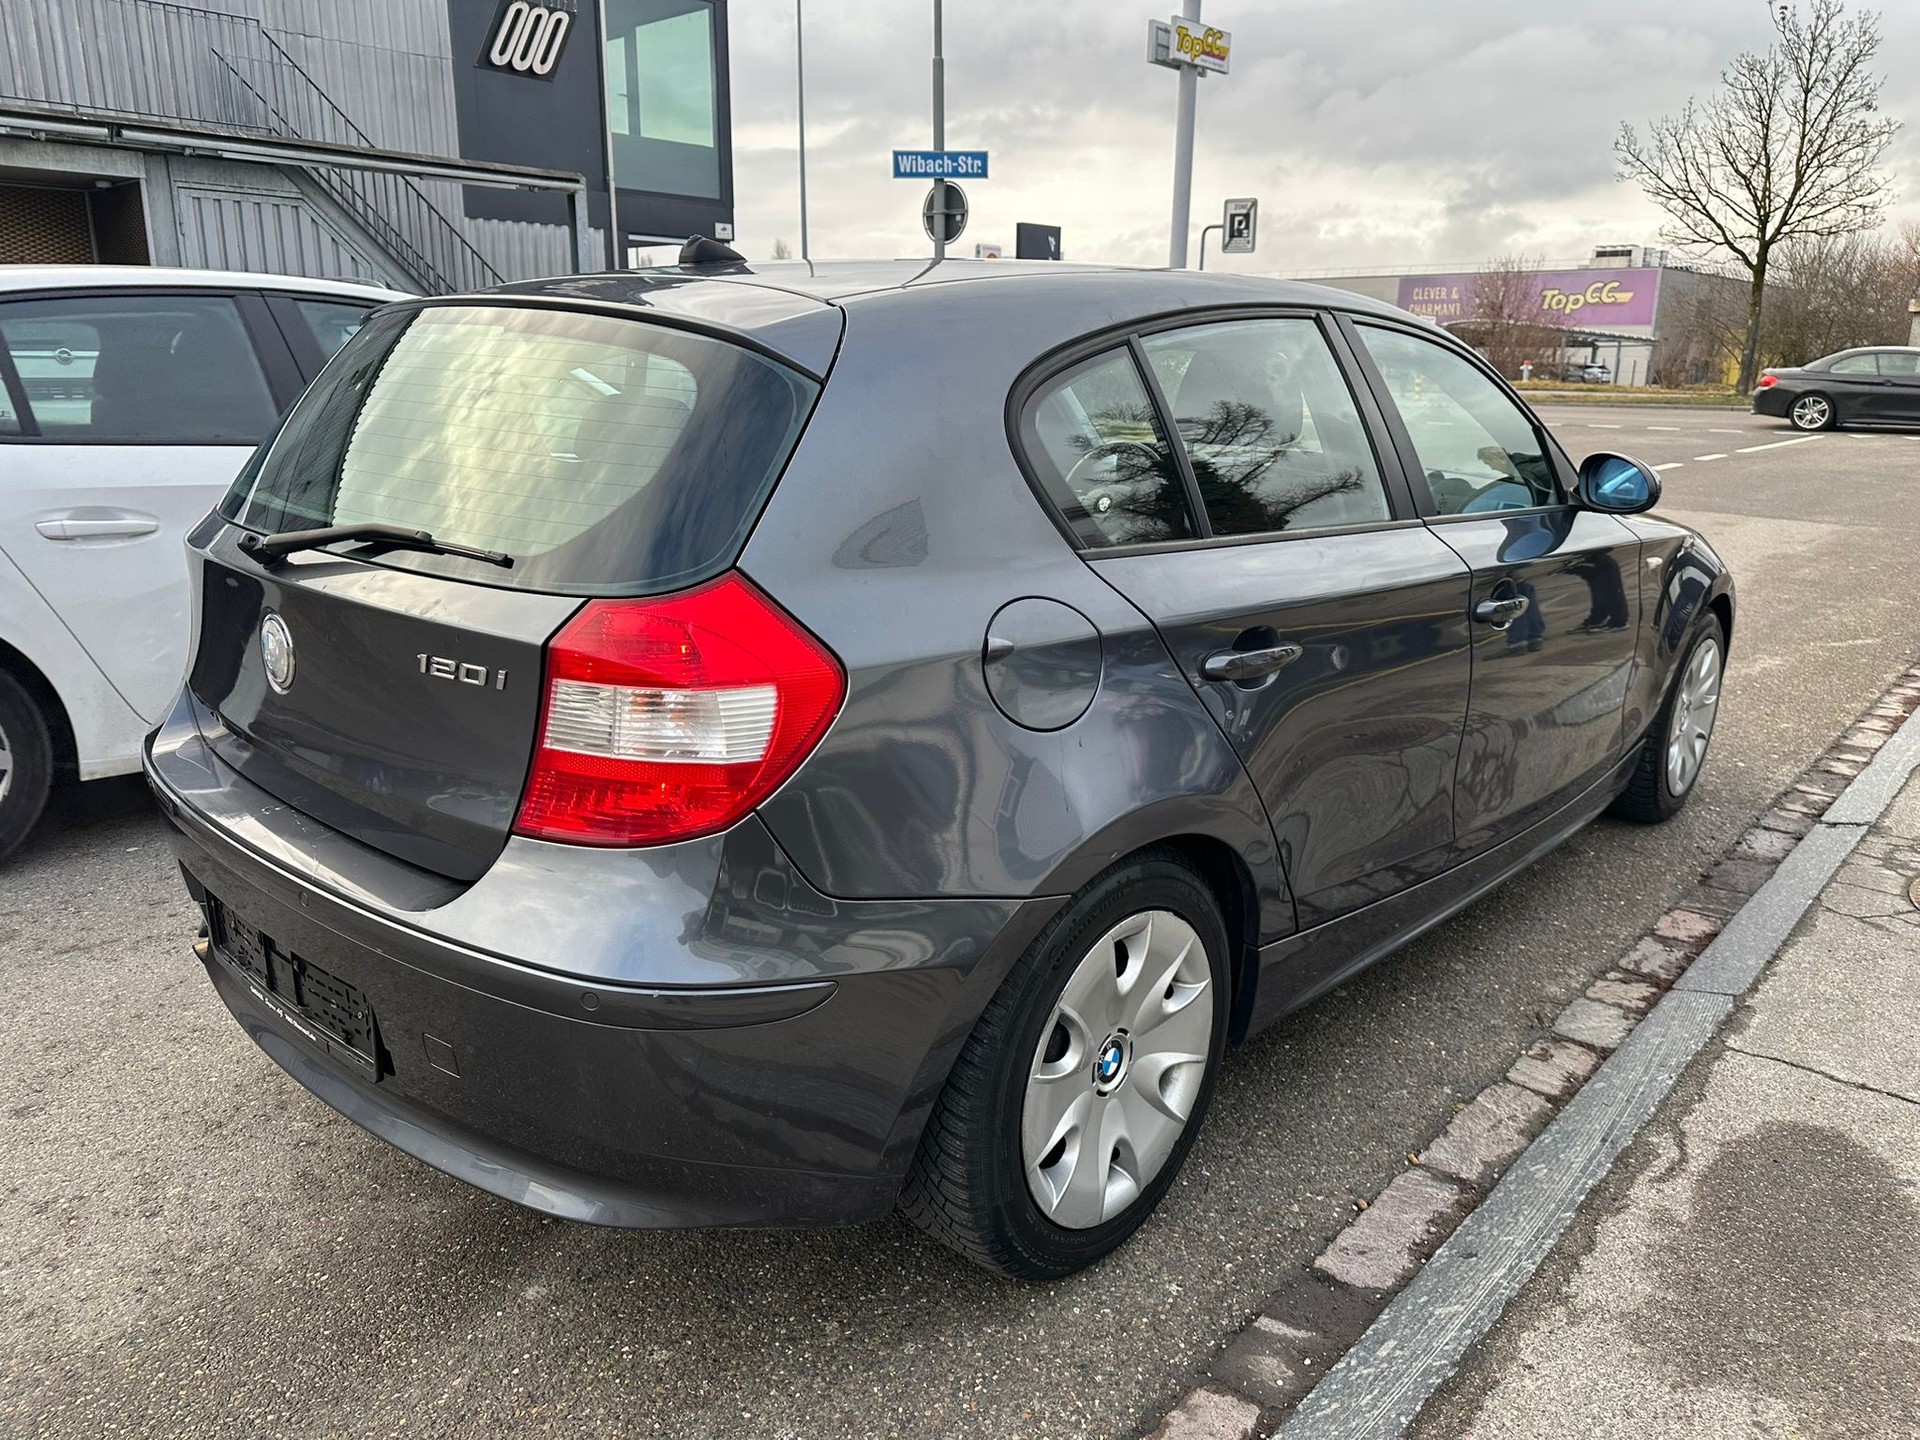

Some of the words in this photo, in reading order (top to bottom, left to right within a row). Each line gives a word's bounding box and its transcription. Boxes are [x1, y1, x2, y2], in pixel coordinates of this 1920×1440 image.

[1176, 26, 1223, 62] TopCC
[898, 154, 982, 174] Wibach-Str.
[1413, 287, 1447, 300] CLEVER
[1451, 286, 1459, 299] &
[1541, 280, 1622, 315] TopCC
[1408, 303, 1461, 316] CHARMANT
